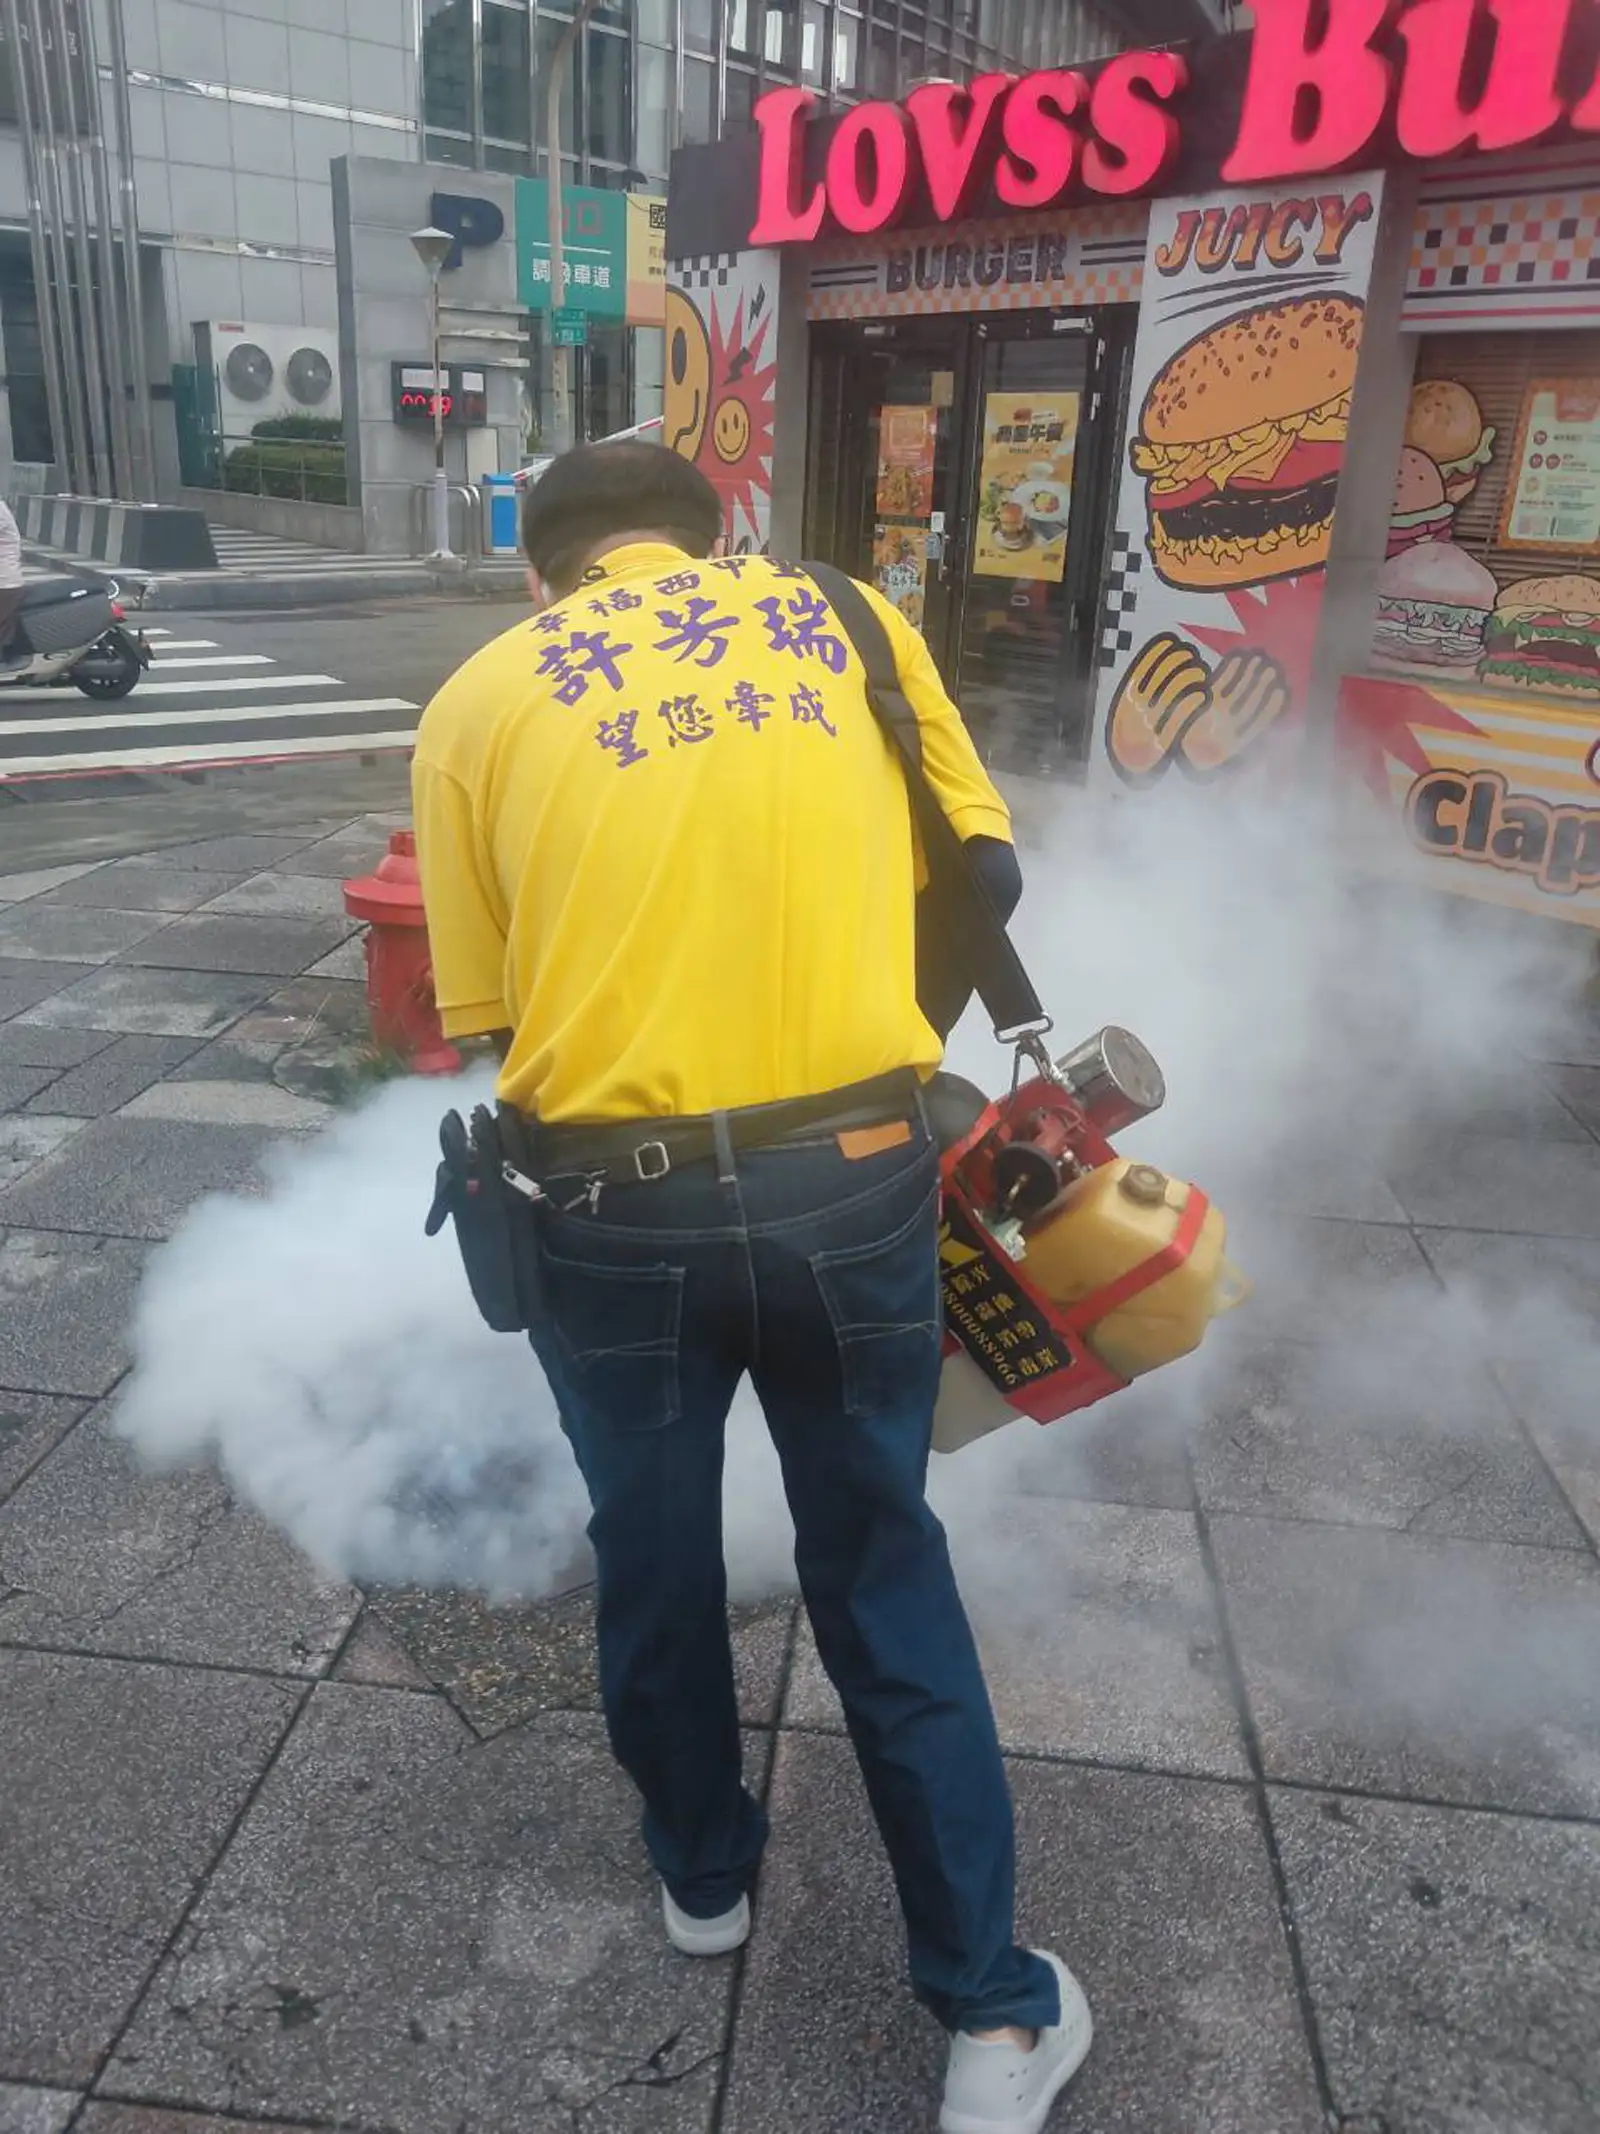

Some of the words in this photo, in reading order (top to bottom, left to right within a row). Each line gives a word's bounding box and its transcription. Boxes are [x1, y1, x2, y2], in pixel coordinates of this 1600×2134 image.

[432, 192, 504, 269] P
[886, 232, 1068, 294] BURGER
[1154, 191, 1374, 277] JUICY
[534, 587, 848, 707] 許芳瑞
